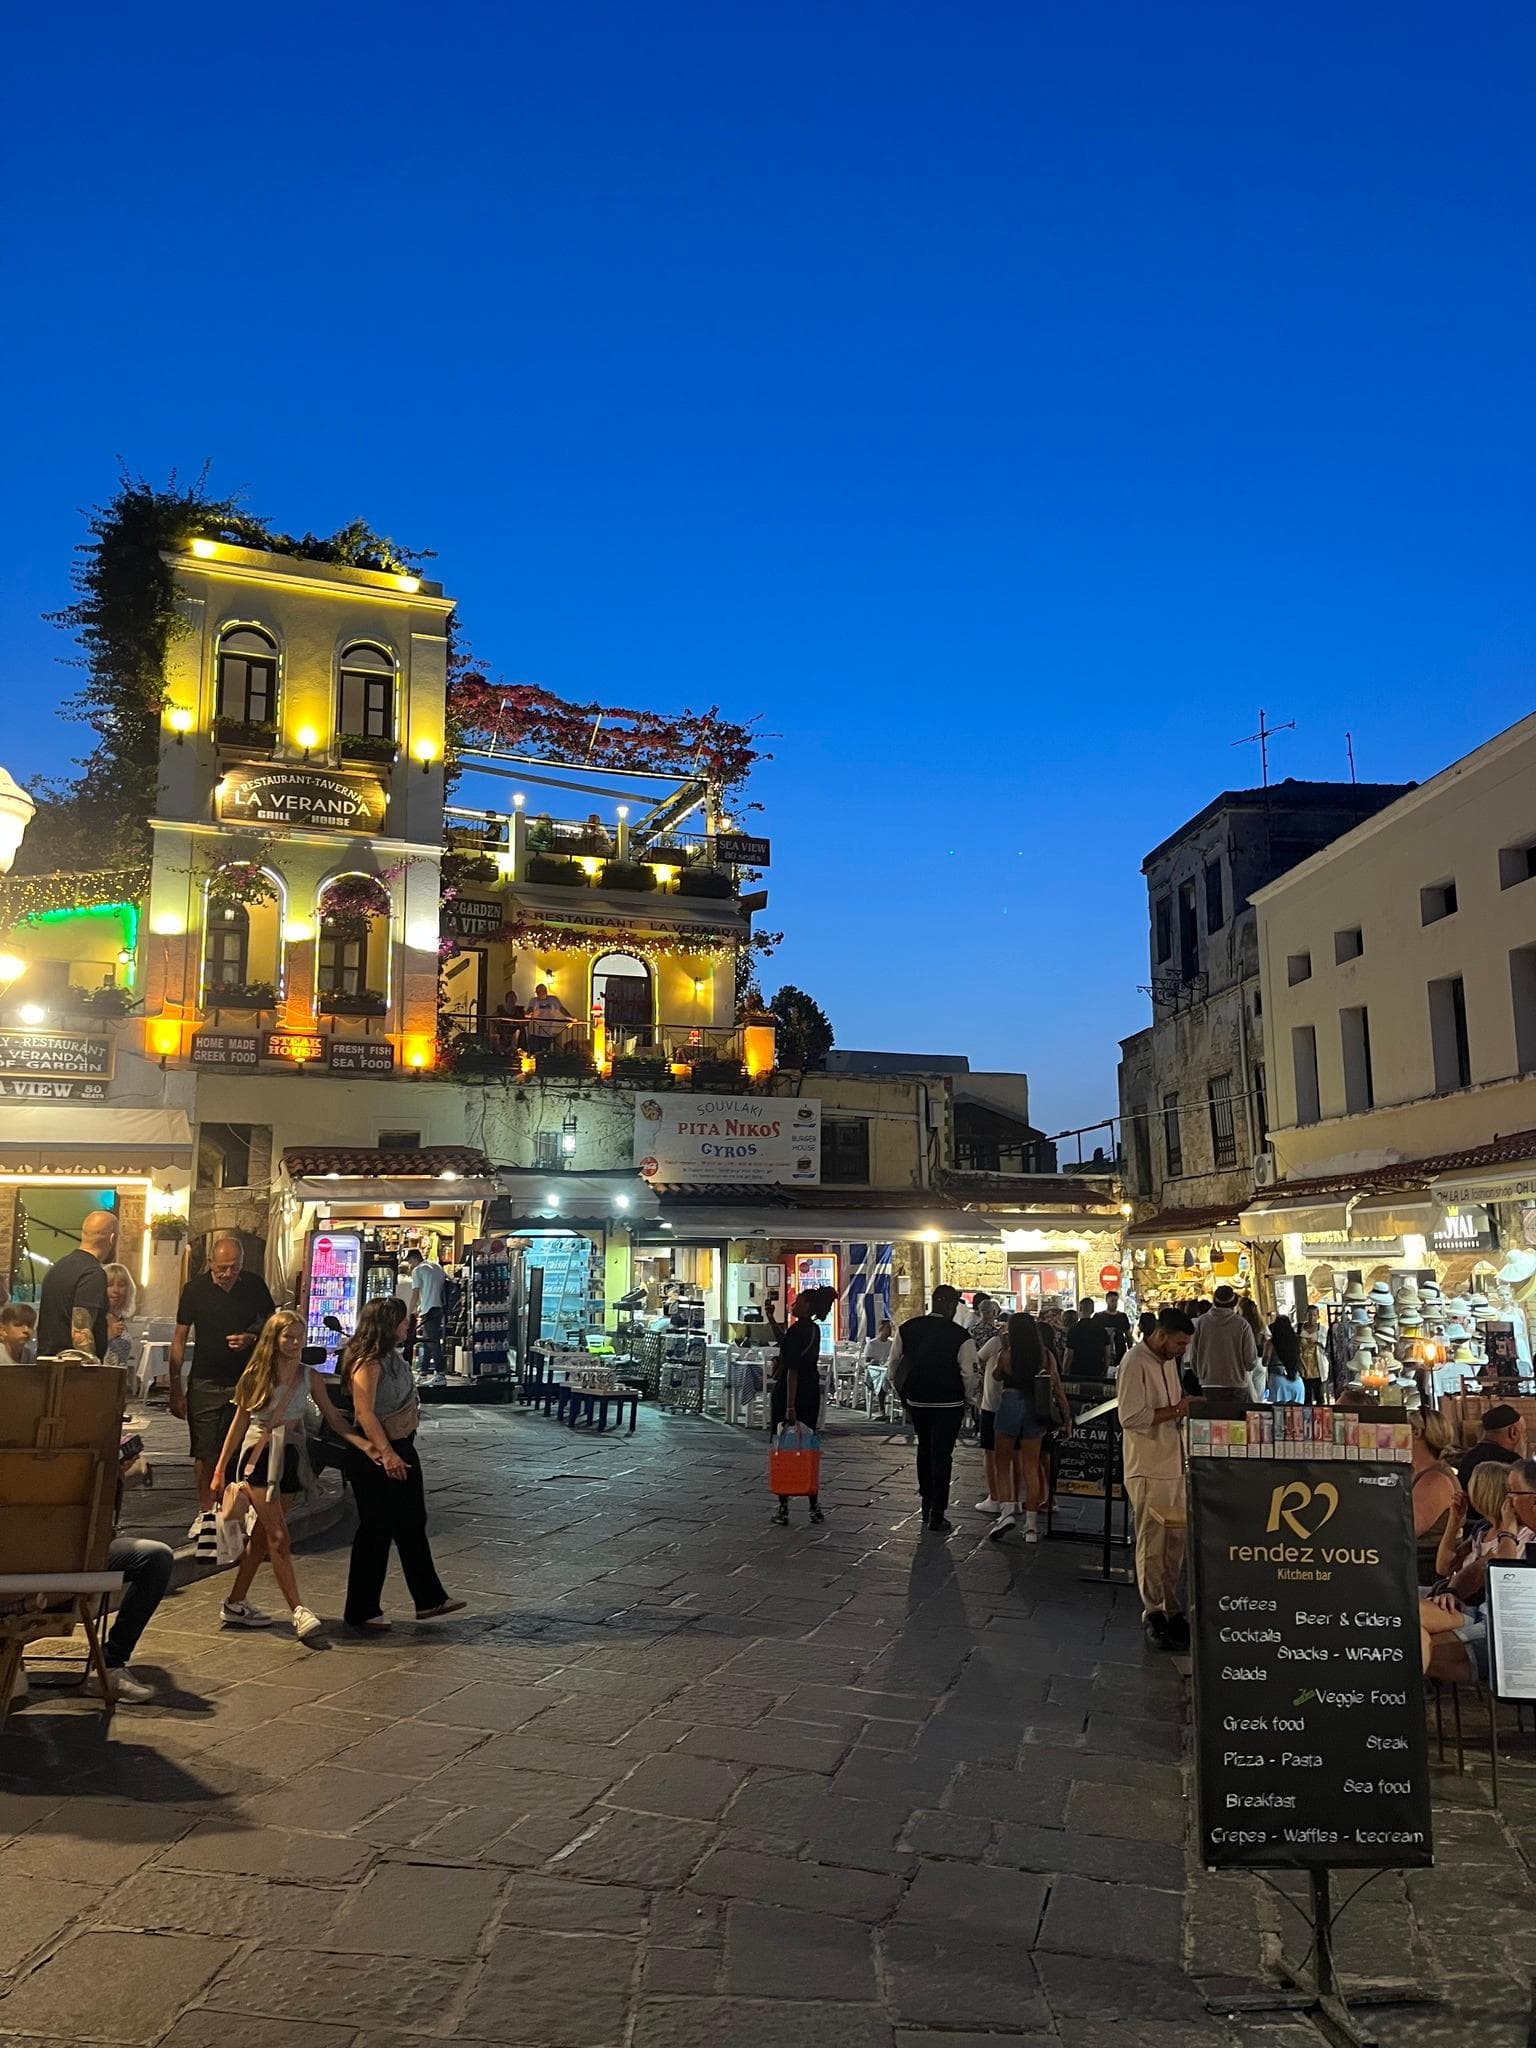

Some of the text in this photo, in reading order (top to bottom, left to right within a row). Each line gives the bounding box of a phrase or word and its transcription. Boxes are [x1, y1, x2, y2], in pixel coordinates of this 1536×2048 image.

[240, 775, 363, 804] RESTAURANT-TAVERNA
[235, 790, 371, 816] LA VERANDA
[258, 810, 350, 826] GRILL HOUSE
[720, 840, 766, 852] SEA VIEW
[460, 902, 500, 917] GARDEN
[534, 912, 634, 928] RESTAURANT
[650, 921, 668, 931] LA
[23, 1038, 106, 1056] RESTAURANT
[196, 1037, 256, 1050] HOME MADE
[269, 1036, 322, 1047] STEAK
[9, 1050, 84, 1062] VERANDA
[194, 1050, 256, 1063] GREEK FOOD
[268, 1046, 322, 1058] HOUSE
[333, 1044, 391, 1056] FRESH FISH
[26, 1061, 102, 1072] GARDEN
[332, 1058, 392, 1070] SEA FOOD
[12, 1081, 74, 1098] VIEW
[696, 1101, 763, 1118] SOUVLAKI
[678, 1122, 720, 1136] PITA
[702, 1142, 757, 1158] GYROS
[1516, 1182, 1528, 1194] OH
[1089, 1430, 1122, 1442] AWY
[1230, 1543, 1380, 1565] rendez vous
[1278, 1568, 1332, 1581] Kitchen bar
[1218, 1596, 1277, 1612] Coffees
[1295, 1612, 1402, 1628] Beer & Ciders
[1219, 1627, 1282, 1642] Cocktails
[1277, 1646, 1328, 1660] Snacks
[1346, 1648, 1403, 1662] WRAPS
[1221, 1666, 1267, 1680] Salads
[1315, 1688, 1406, 1708] Veggie Food
[1224, 1716, 1304, 1731] Greek food
[1366, 1735, 1408, 1749] Steak
[1224, 1752, 1264, 1766] Pizza
[1282, 1752, 1323, 1767] Pasta
[1344, 1779, 1411, 1794] Sea food
[1226, 1793, 1296, 1808] Breakfast
[1211, 1828, 1266, 1845] Crepes
[1284, 1828, 1338, 1843] Waffles
[1356, 1828, 1424, 1843] Icecream
